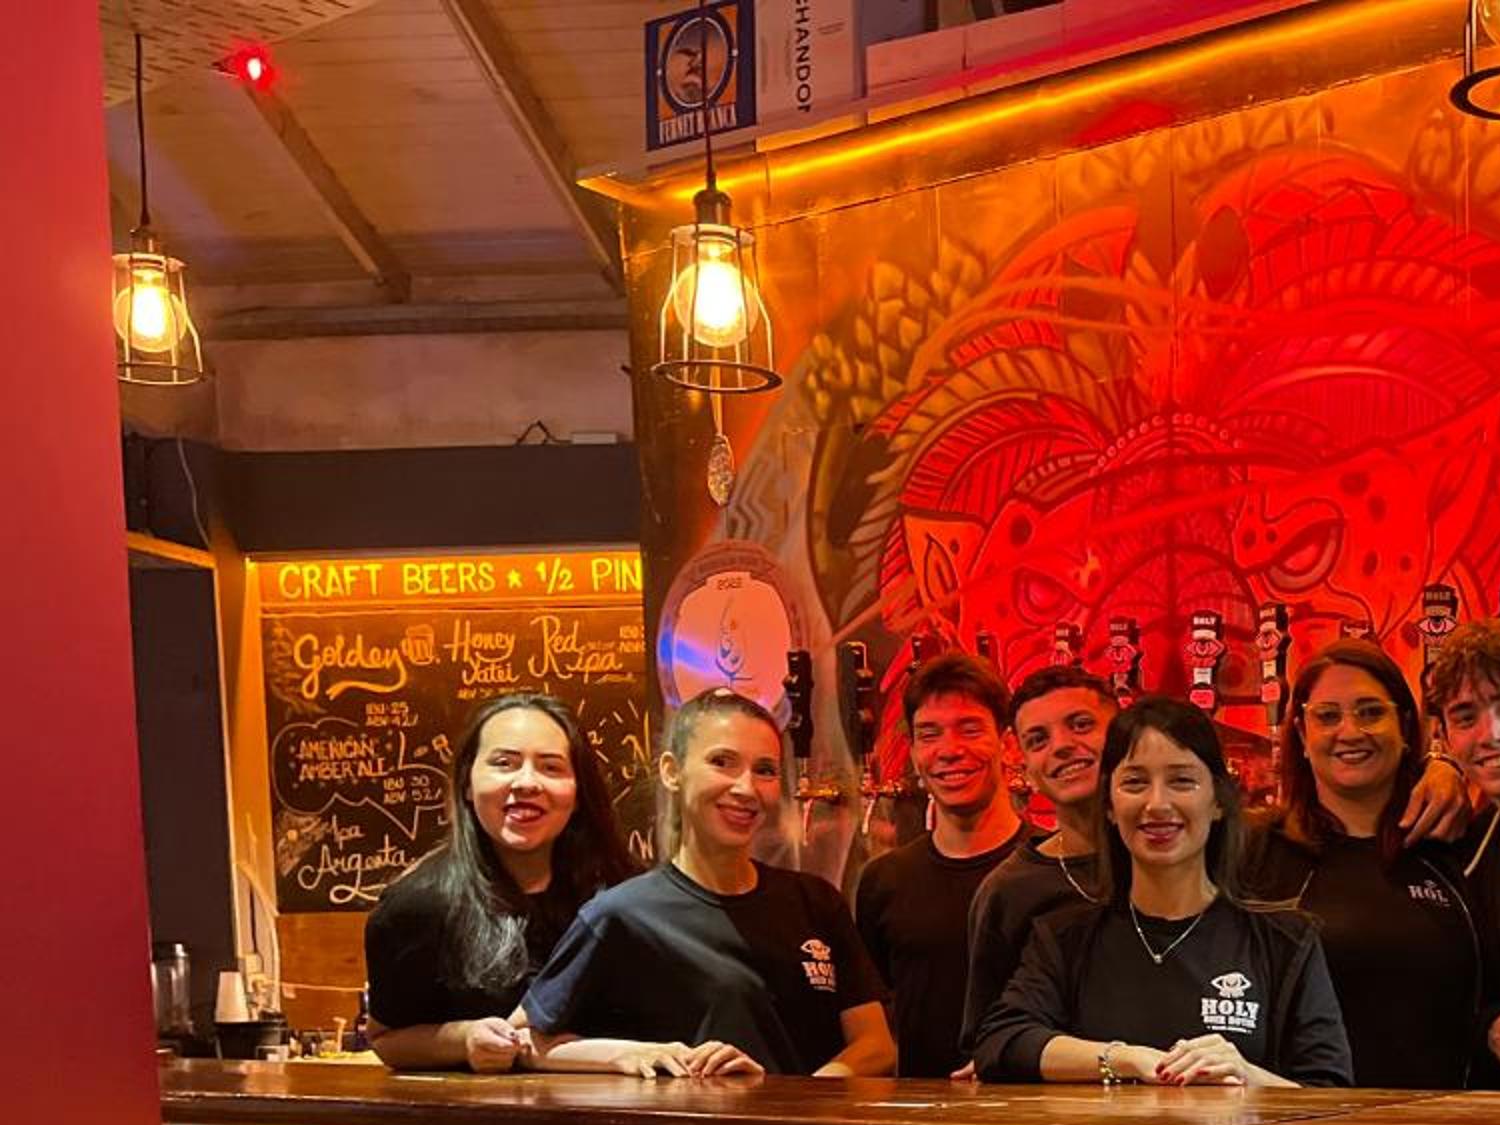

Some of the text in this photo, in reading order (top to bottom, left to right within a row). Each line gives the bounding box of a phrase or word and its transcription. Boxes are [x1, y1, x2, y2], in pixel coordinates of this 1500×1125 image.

[279, 563, 383, 599] CRAFT
[402, 561, 496, 596] BEERS
[443, 618, 516, 663] Honey
[528, 615, 587, 679] Red
[297, 736, 376, 760] AMERICAN
[299, 760, 352, 782] AMBER
[1201, 998, 1260, 1020] HOLY
